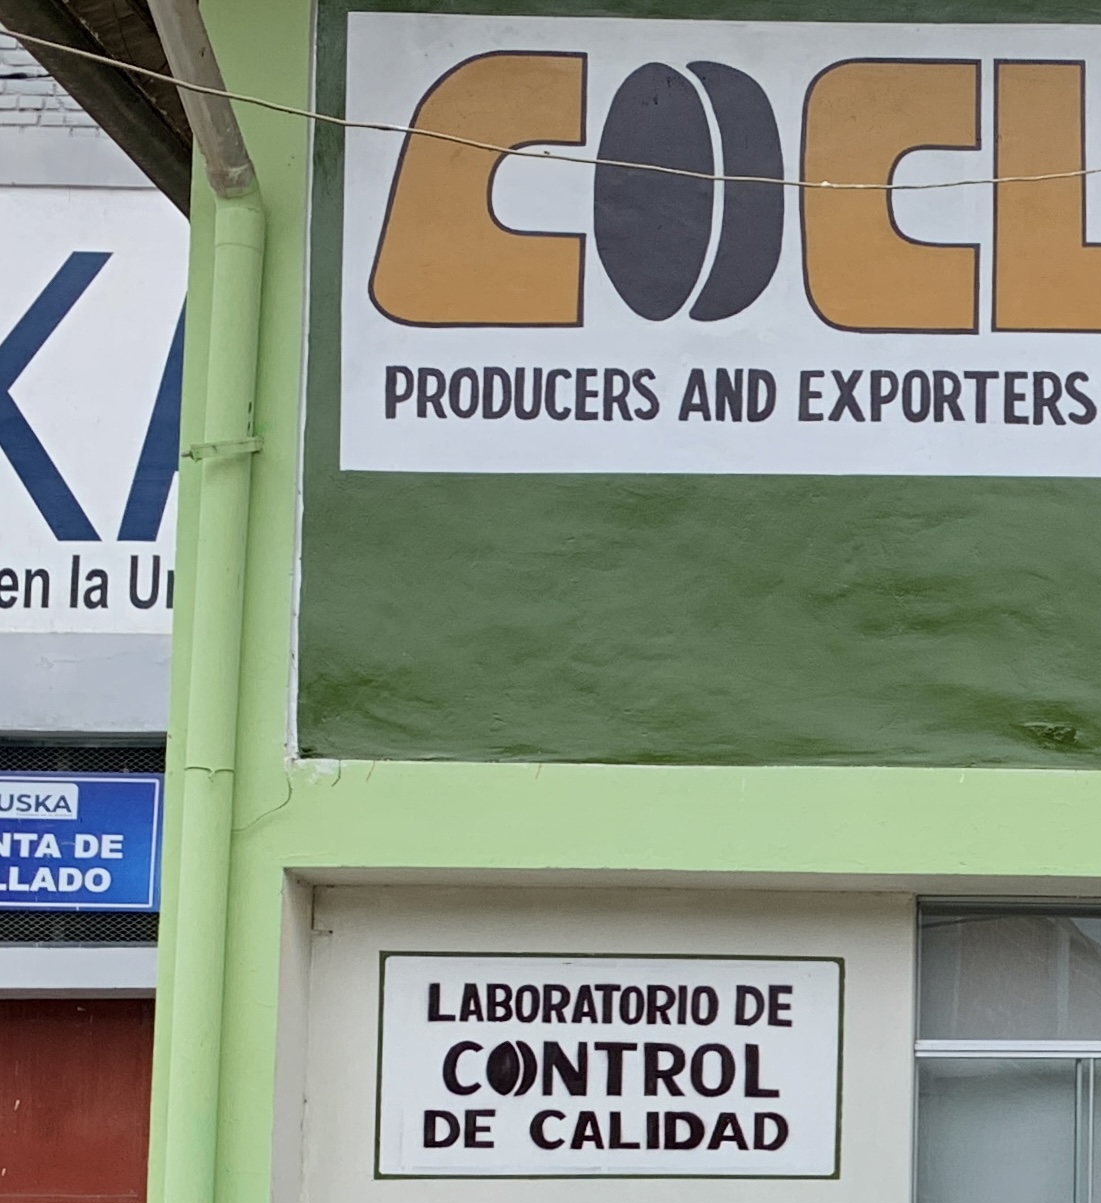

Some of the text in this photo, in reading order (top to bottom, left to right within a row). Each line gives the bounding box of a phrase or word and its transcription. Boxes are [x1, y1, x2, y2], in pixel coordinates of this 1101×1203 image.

[384, 365, 660, 422] PRODUCERS
[678, 367, 777, 423] AND
[799, 369, 1097, 426] EXPORTERS
[0, 568, 50, 609] en
[69, 554, 109, 610] la
[0, 793, 72, 813] USKA
[74, 833, 124, 859] DE
[427, 982, 793, 1028] LABORATORIO DE
[442, 1040, 780, 1098] CONTROL
[423, 1109, 789, 1152] DE CALIDAD
